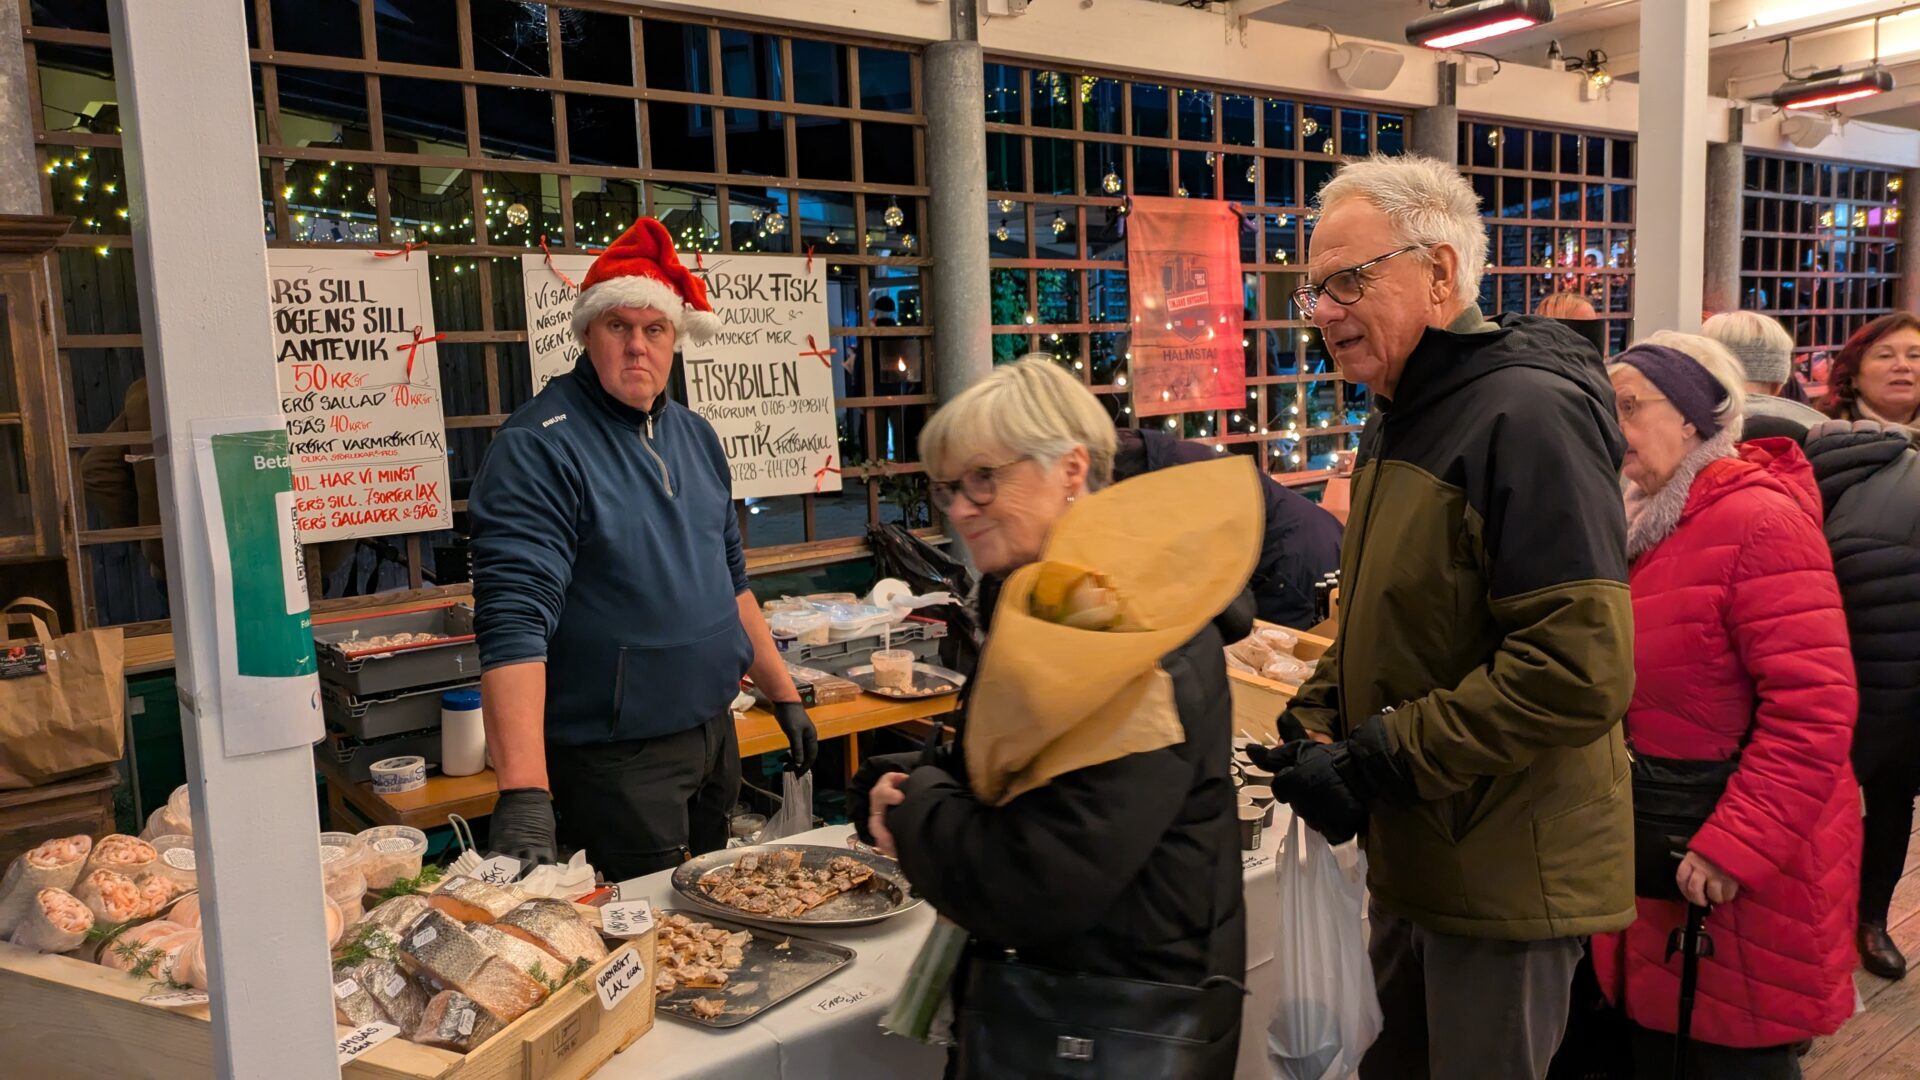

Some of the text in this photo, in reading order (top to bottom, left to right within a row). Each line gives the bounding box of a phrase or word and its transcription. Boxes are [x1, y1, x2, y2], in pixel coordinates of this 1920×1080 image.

[272, 278, 378, 304] RS SILL
[689, 260, 822, 303] ÄRSK FISK
[535, 281, 549, 309] VI
[362, 306, 414, 334] SILL
[535, 327, 565, 355] EGEN
[715, 329, 763, 346] MYCKET
[766, 330, 798, 346] MER
[277, 337, 389, 362] ANTEVIK
[563, 345, 584, 362] VA
[292, 363, 328, 392] 50
[686, 358, 800, 402] FISKBILEN
[320, 392, 386, 411] SALLAD
[330, 414, 349, 433] 40
[755, 421, 766, 434] &
[320, 472, 357, 488] HAR
[359, 468, 372, 484] VI
[378, 465, 423, 483] MINST
[373, 488, 413, 505] SORTER
[416, 482, 441, 503] LAX
[331, 508, 401, 528] SALLADER
[403, 508, 413, 518] &
[607, 979, 629, 1001] LAX
